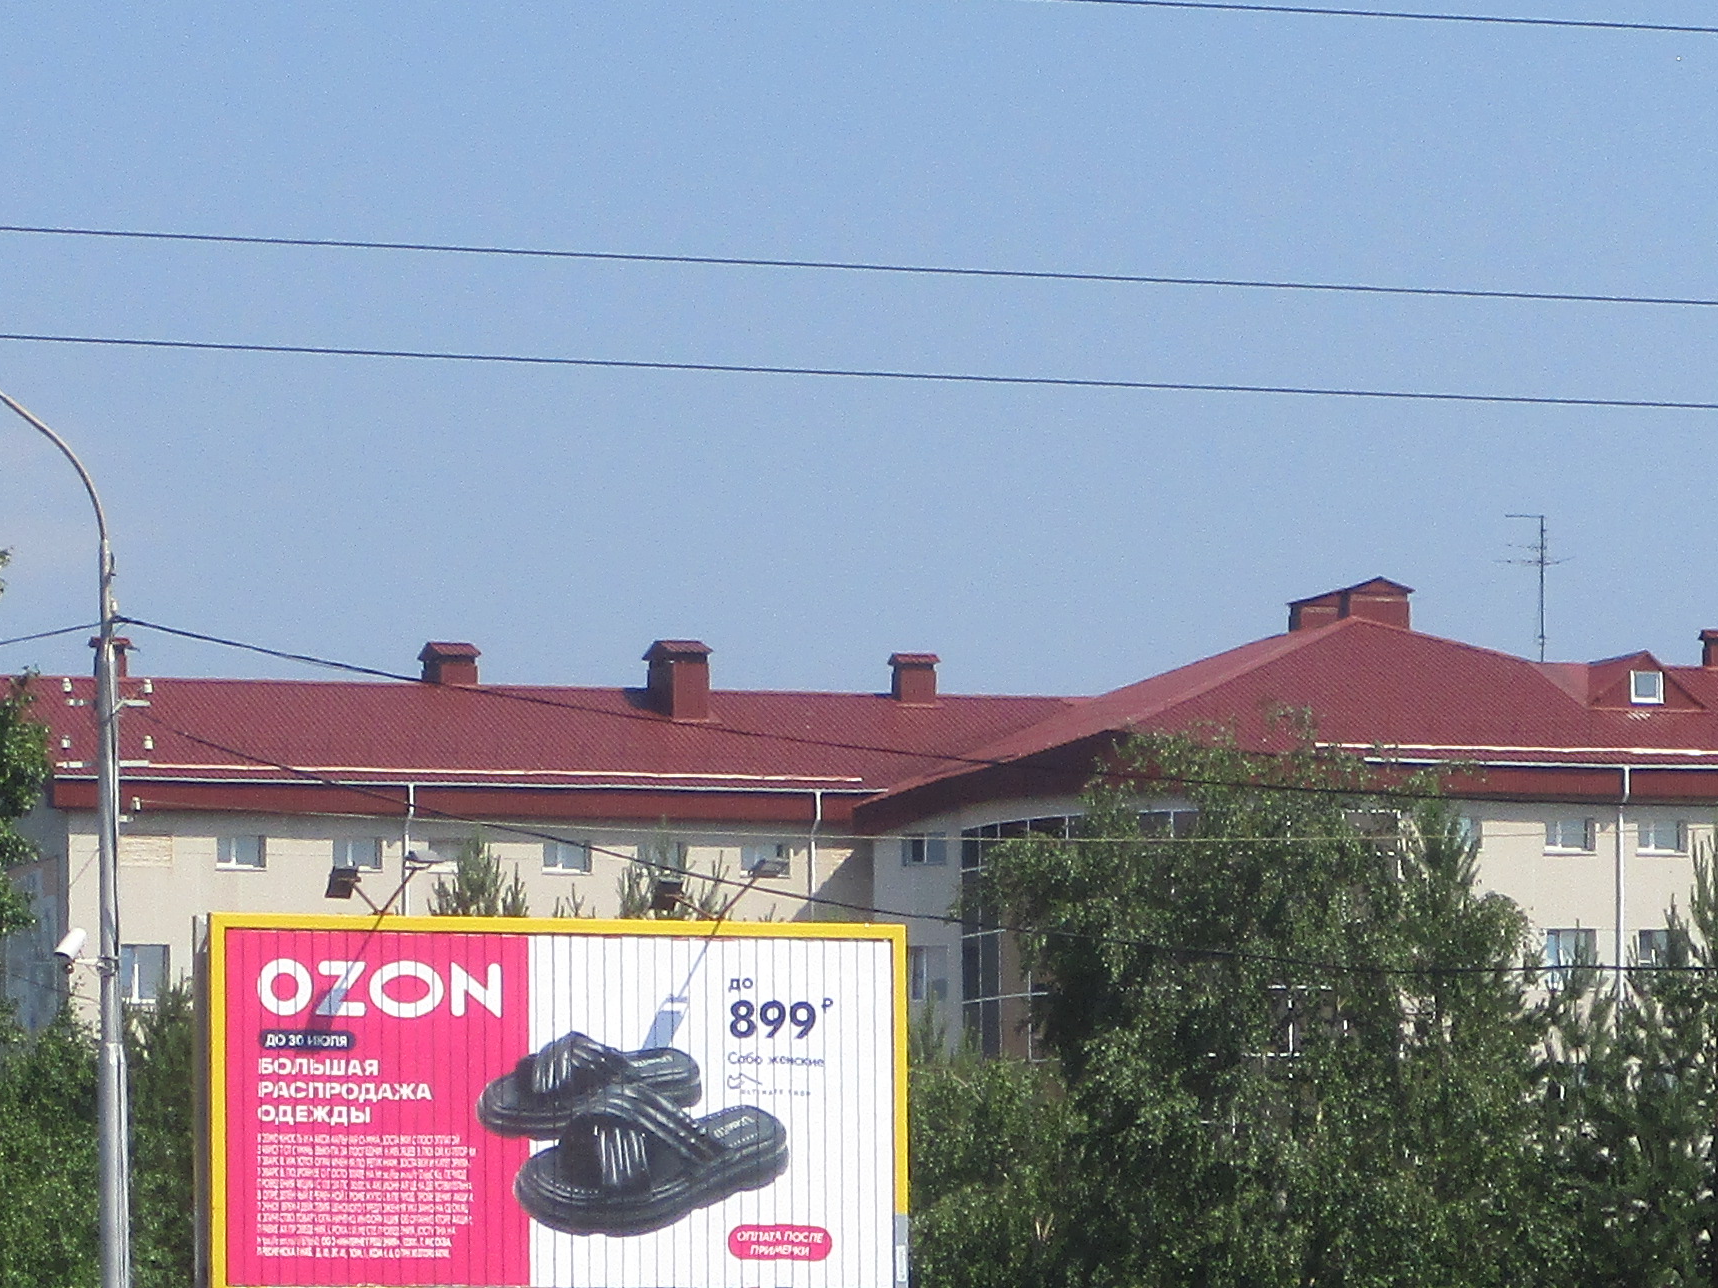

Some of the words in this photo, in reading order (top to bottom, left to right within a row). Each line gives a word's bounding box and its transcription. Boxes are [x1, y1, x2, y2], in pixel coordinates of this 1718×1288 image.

[257, 958, 504, 1019] OZON
[265, 1033, 286, 1048] ДО
[288, 1033, 304, 1047] 30
[258, 1057, 379, 1076] БОЛЬШАЯ
[258, 1081, 433, 1103] РАСПРОДАЖА
[257, 1104, 372, 1127] ОДЕЖДЫ
[737, 1230, 782, 1243] ОПЛАТА
[784, 1231, 825, 1244] ПОСЛЕ
